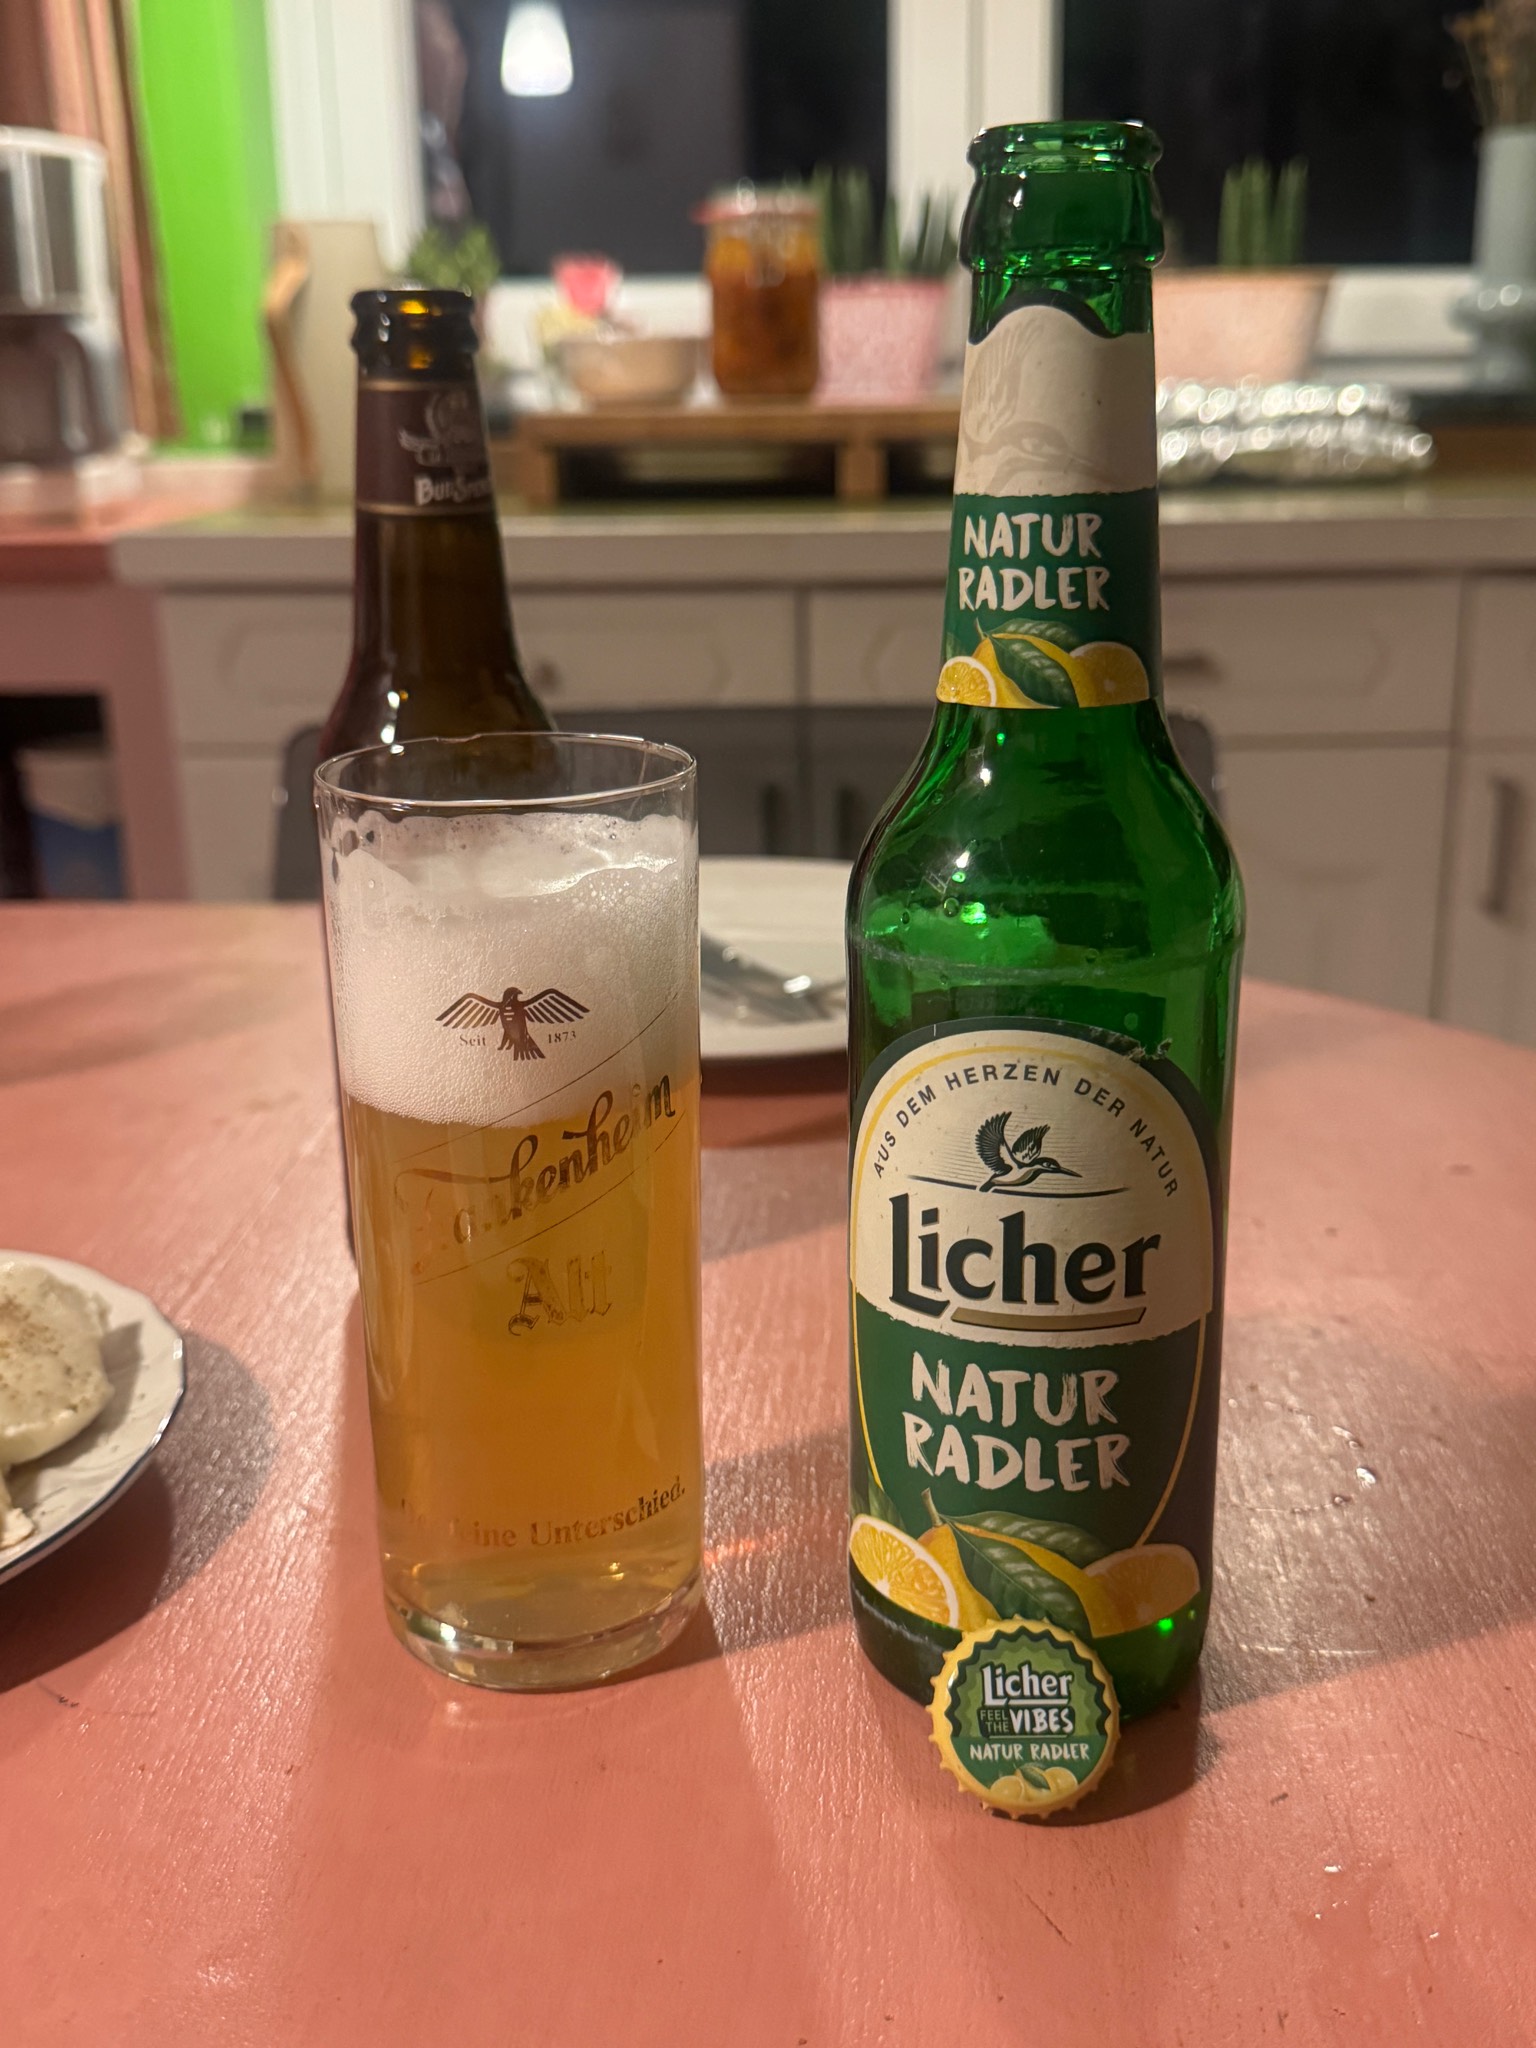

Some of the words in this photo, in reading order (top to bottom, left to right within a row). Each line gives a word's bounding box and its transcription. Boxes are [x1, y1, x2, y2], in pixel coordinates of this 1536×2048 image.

[964, 512, 1102, 560] NATUR
[958, 565, 1110, 612] RADLER
[459, 1033, 486, 1047] Seit
[548, 1030, 577, 1044] 1873
[872, 1130, 897, 1180] AUS
[895, 1084, 937, 1129] DEM
[944, 1062, 1061, 1092] HERZEN
[1073, 1077, 1126, 1118] DER
[1129, 1118, 1179, 1198] NATUR
[888, 1192, 1162, 1318] Licher
[911, 1350, 1119, 1428] NATUR
[901, 1411, 1131, 1493] RADLER
[982, 1664, 1072, 1706] Licher
[980, 1709, 1008, 1721] FEEL
[1009, 1708, 1074, 1734] VIBES
[986, 1722, 1009, 1733] THE
[969, 1743, 1024, 1761] NATUR
[1030, 1742, 1090, 1761] RADLER
